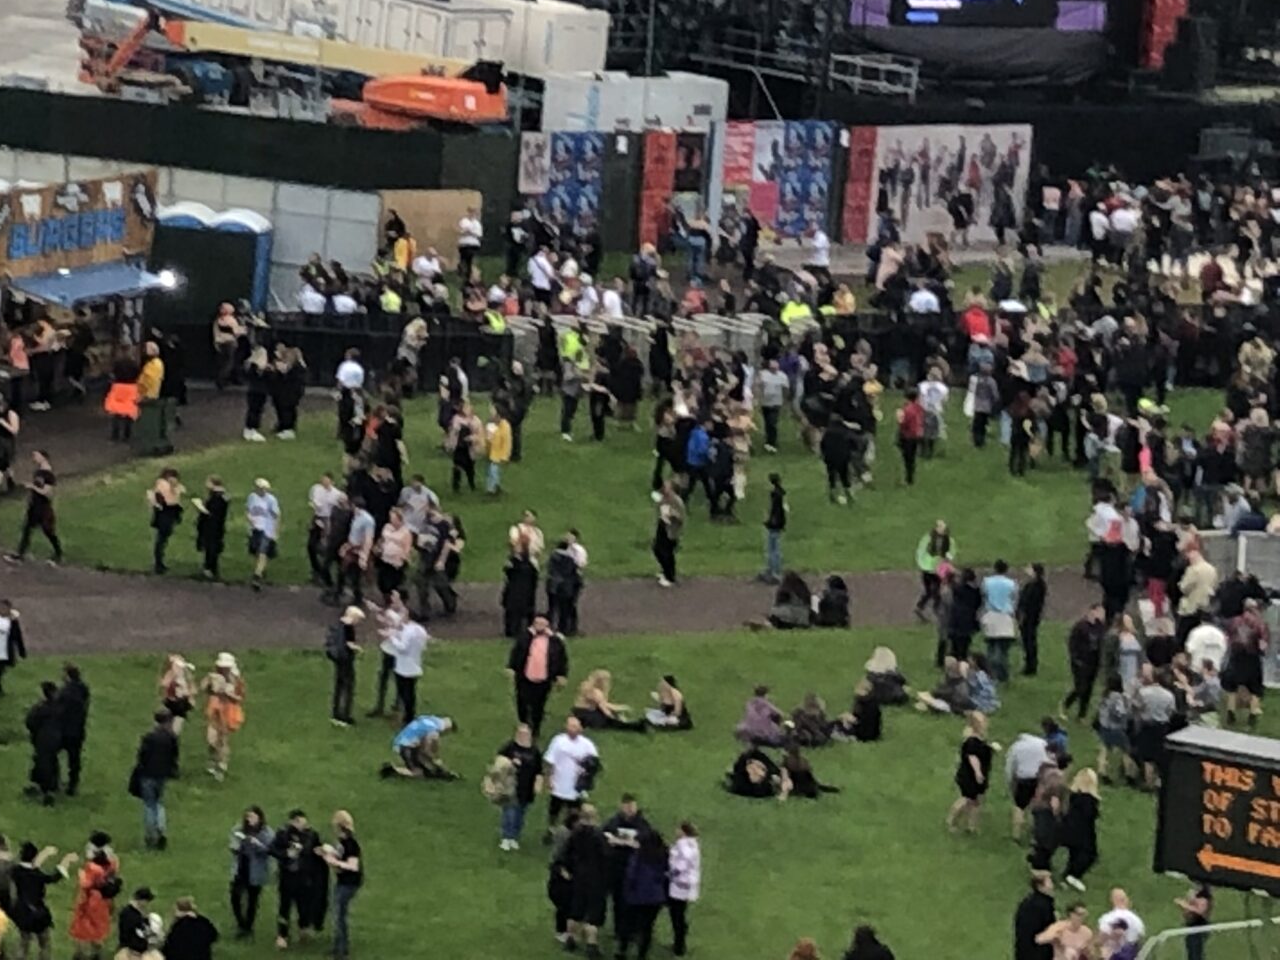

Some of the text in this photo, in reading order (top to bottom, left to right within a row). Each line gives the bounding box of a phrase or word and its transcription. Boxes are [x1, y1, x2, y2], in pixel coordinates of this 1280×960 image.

[1201, 762, 1256, 790] THIS
[1202, 790, 1234, 811] OF
[1202, 814, 1233, 839] TO
